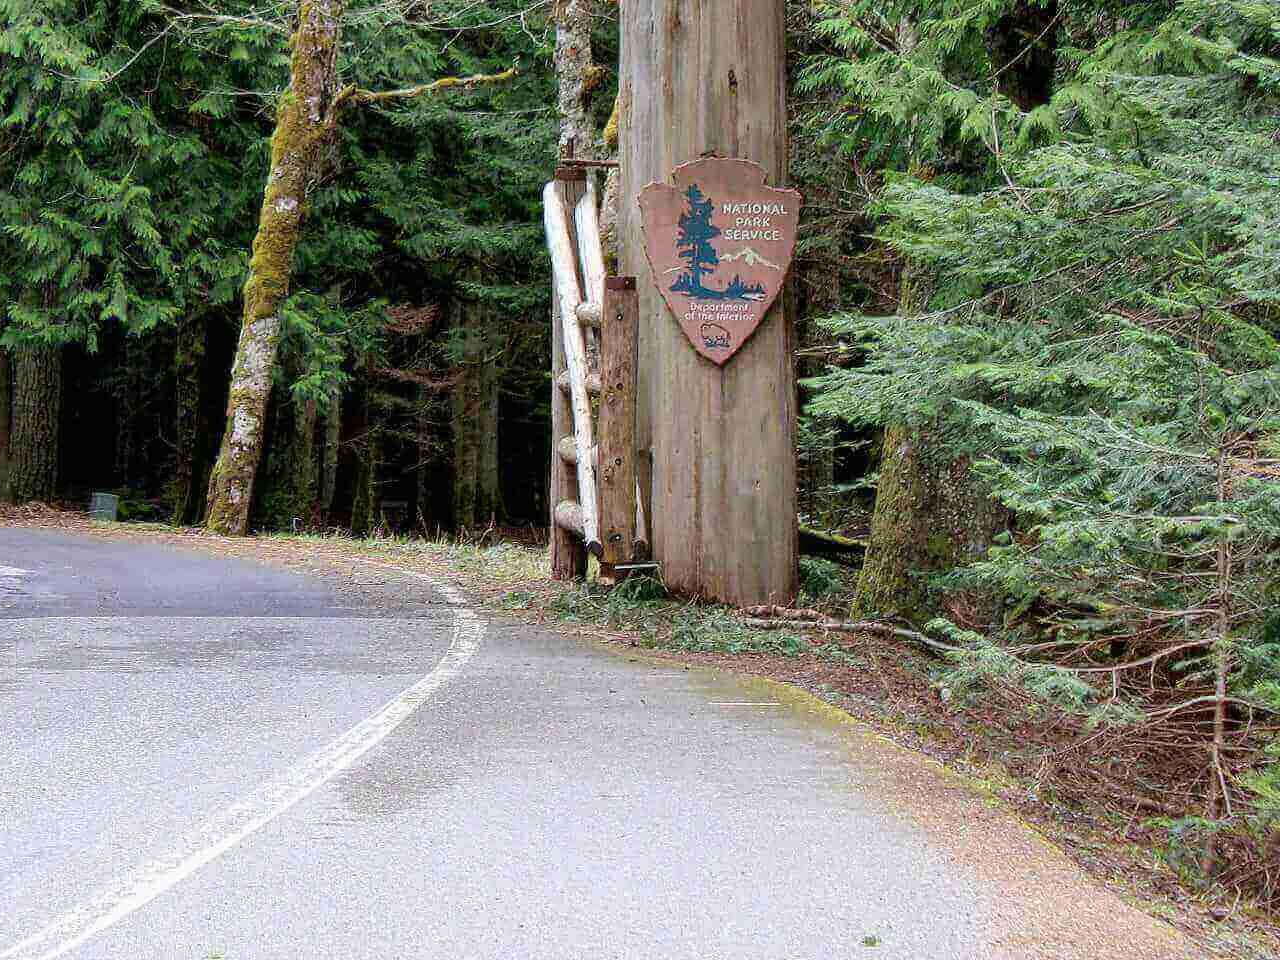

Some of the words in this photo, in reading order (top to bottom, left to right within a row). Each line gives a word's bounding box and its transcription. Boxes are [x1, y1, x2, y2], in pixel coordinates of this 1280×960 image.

[722, 203, 789, 215] NATIONAL
[735, 216, 771, 227] PARK
[724, 229, 780, 241] SERVICE
